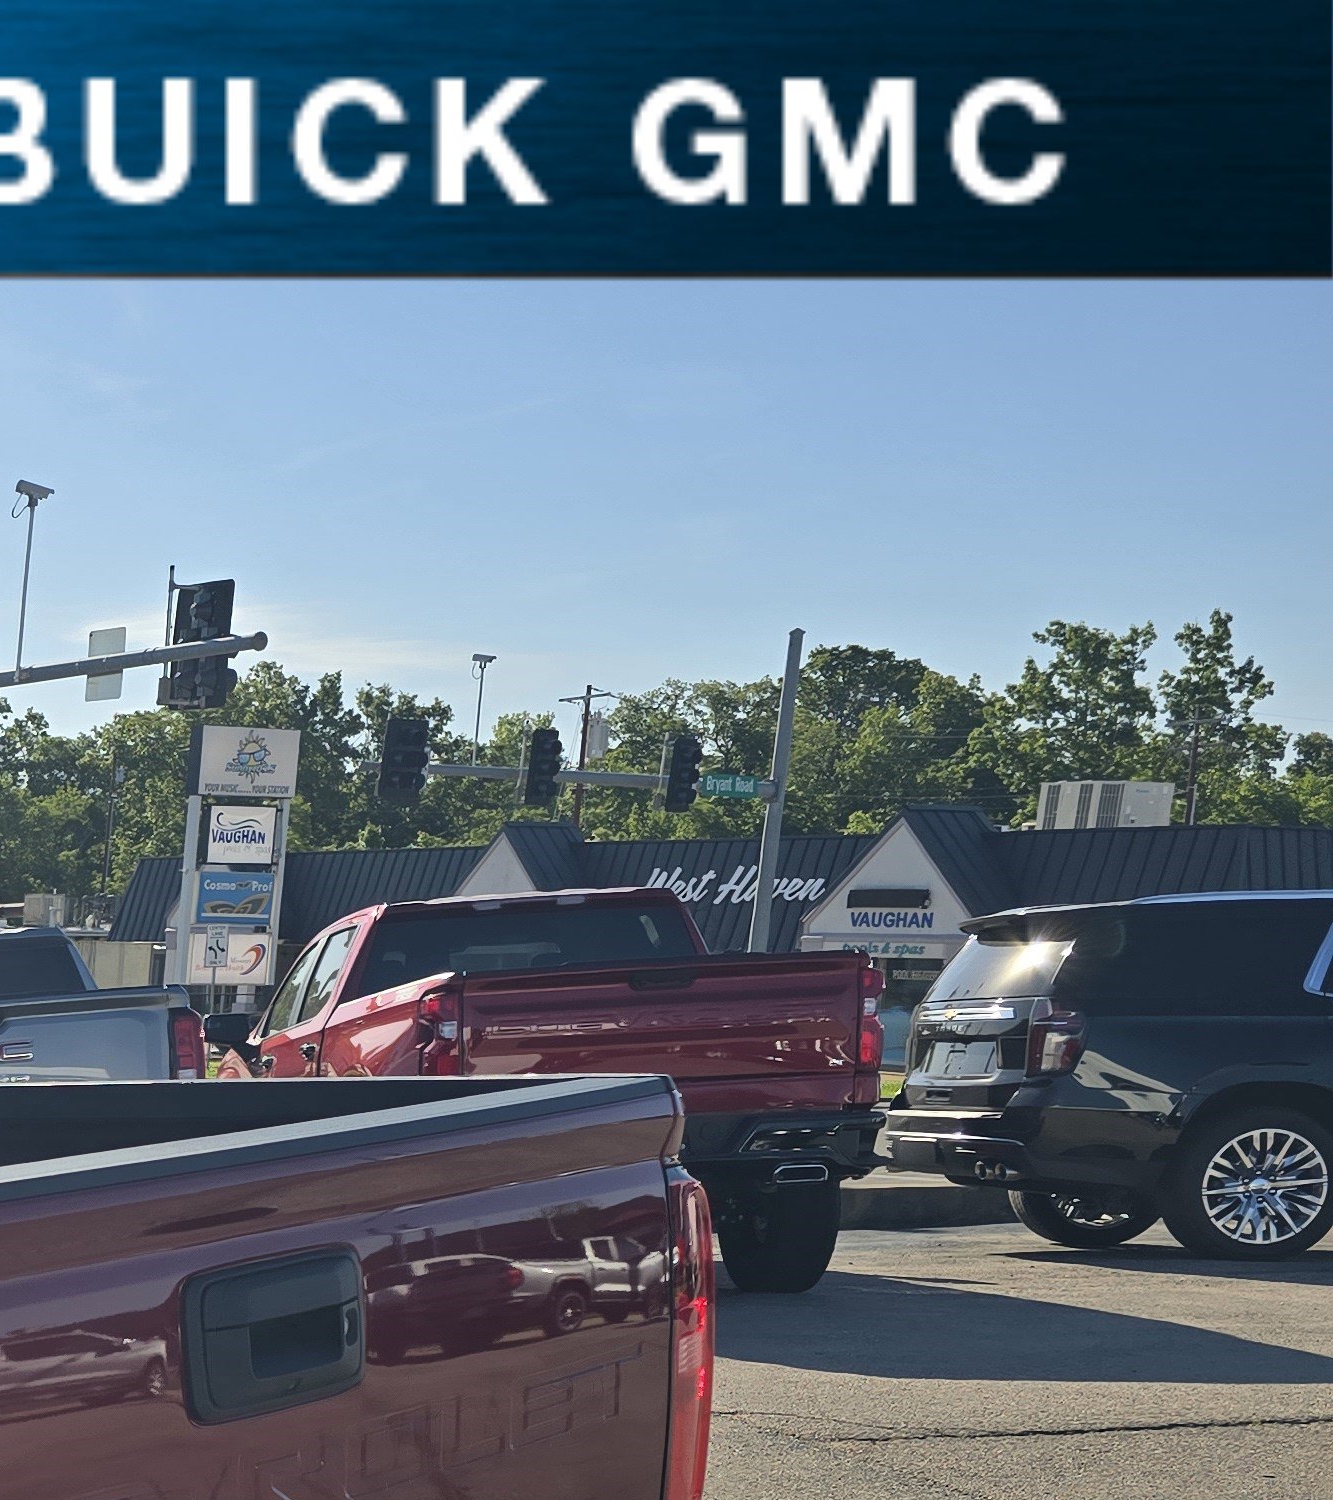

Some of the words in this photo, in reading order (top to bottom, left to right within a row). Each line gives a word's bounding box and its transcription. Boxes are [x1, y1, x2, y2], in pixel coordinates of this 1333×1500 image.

[205, 783, 220, 793] YOUR
[252, 785, 267, 794] YOUR
[267, 785, 290, 795] STATION
[706, 775, 733, 794] Bryant
[735, 776, 755, 793] Road
[211, 828, 266, 844] VAUGHAN
[203, 879, 237, 891] Cosmo
[645, 866, 717, 903] West
[850, 911, 934, 929] VAUGHAN
